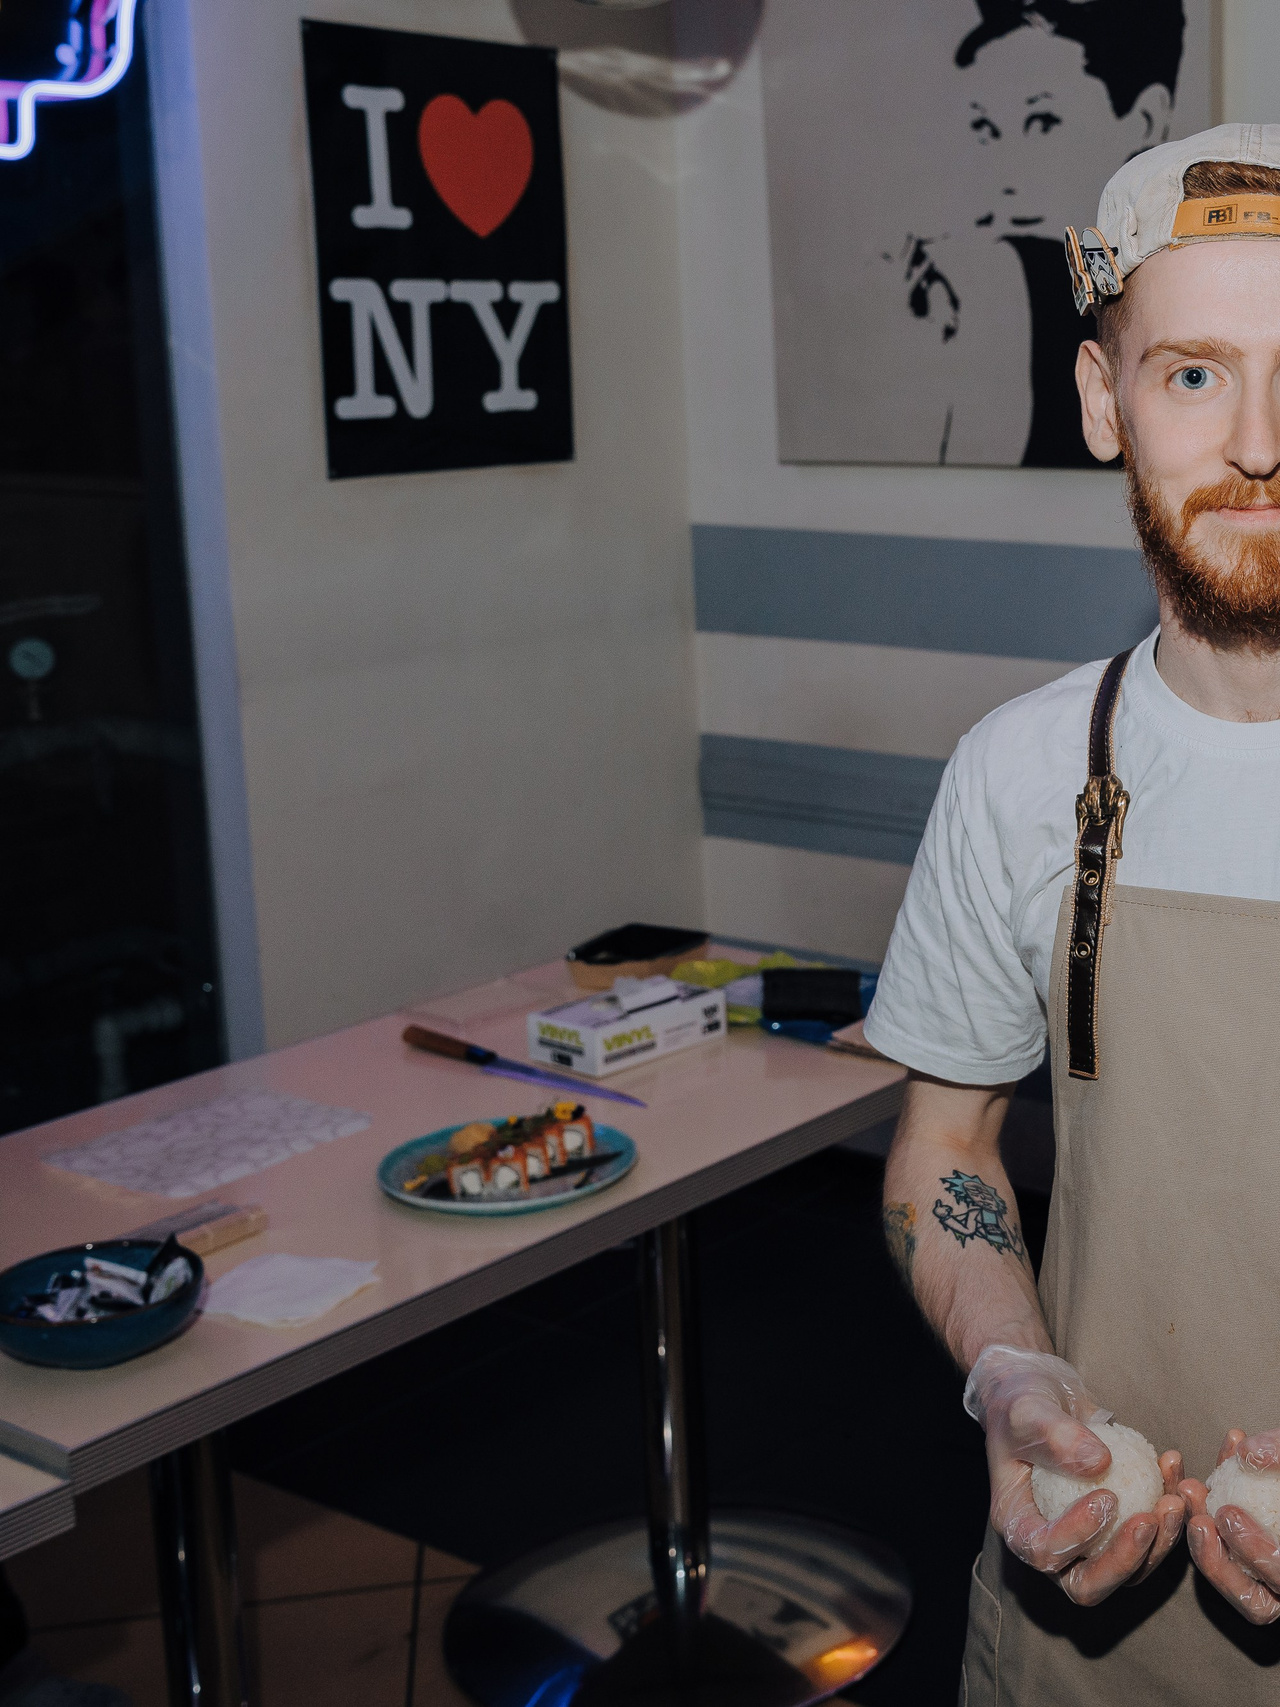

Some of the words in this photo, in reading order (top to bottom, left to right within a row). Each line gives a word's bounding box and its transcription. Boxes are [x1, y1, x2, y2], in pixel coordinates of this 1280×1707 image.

[343, 86, 412, 229] I
[330, 278, 560, 419] NY
[538, 1022, 583, 1046] VINYL
[603, 1026, 655, 1050] VINYL
